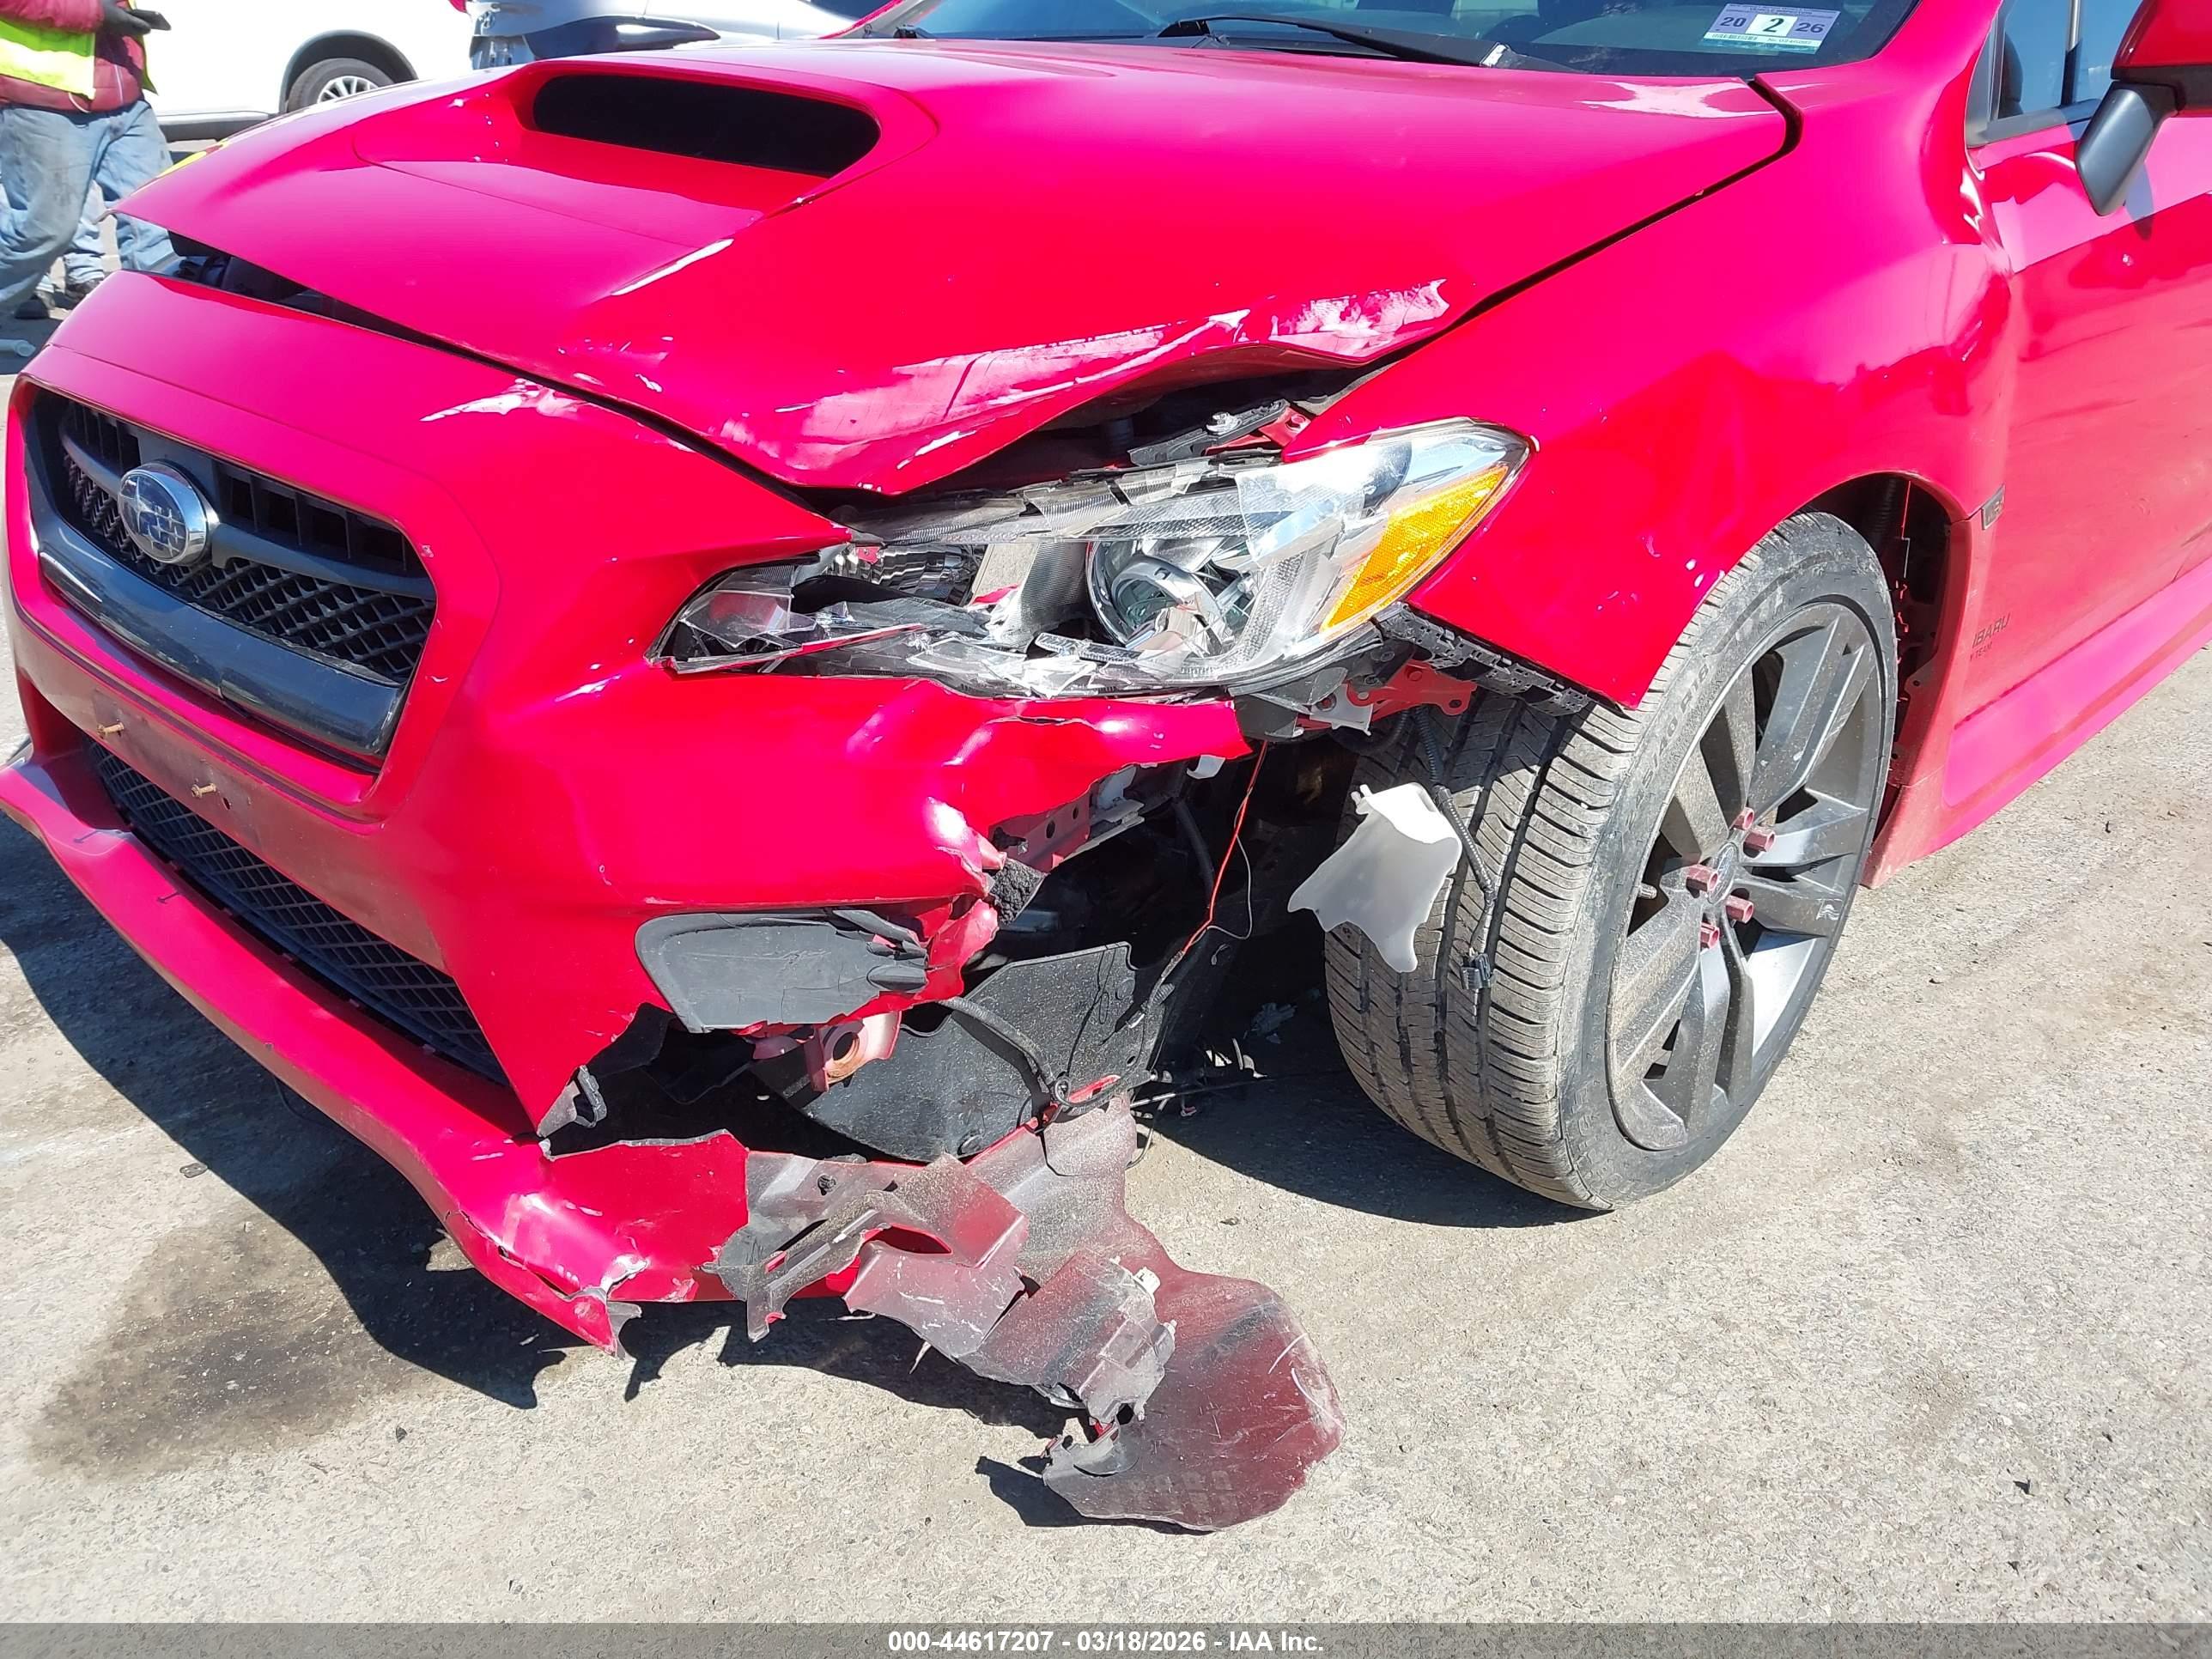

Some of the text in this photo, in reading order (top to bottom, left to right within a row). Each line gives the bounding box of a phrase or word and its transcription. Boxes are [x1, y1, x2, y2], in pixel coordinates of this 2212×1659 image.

[1720, 16, 1826, 33] 20 2 26
